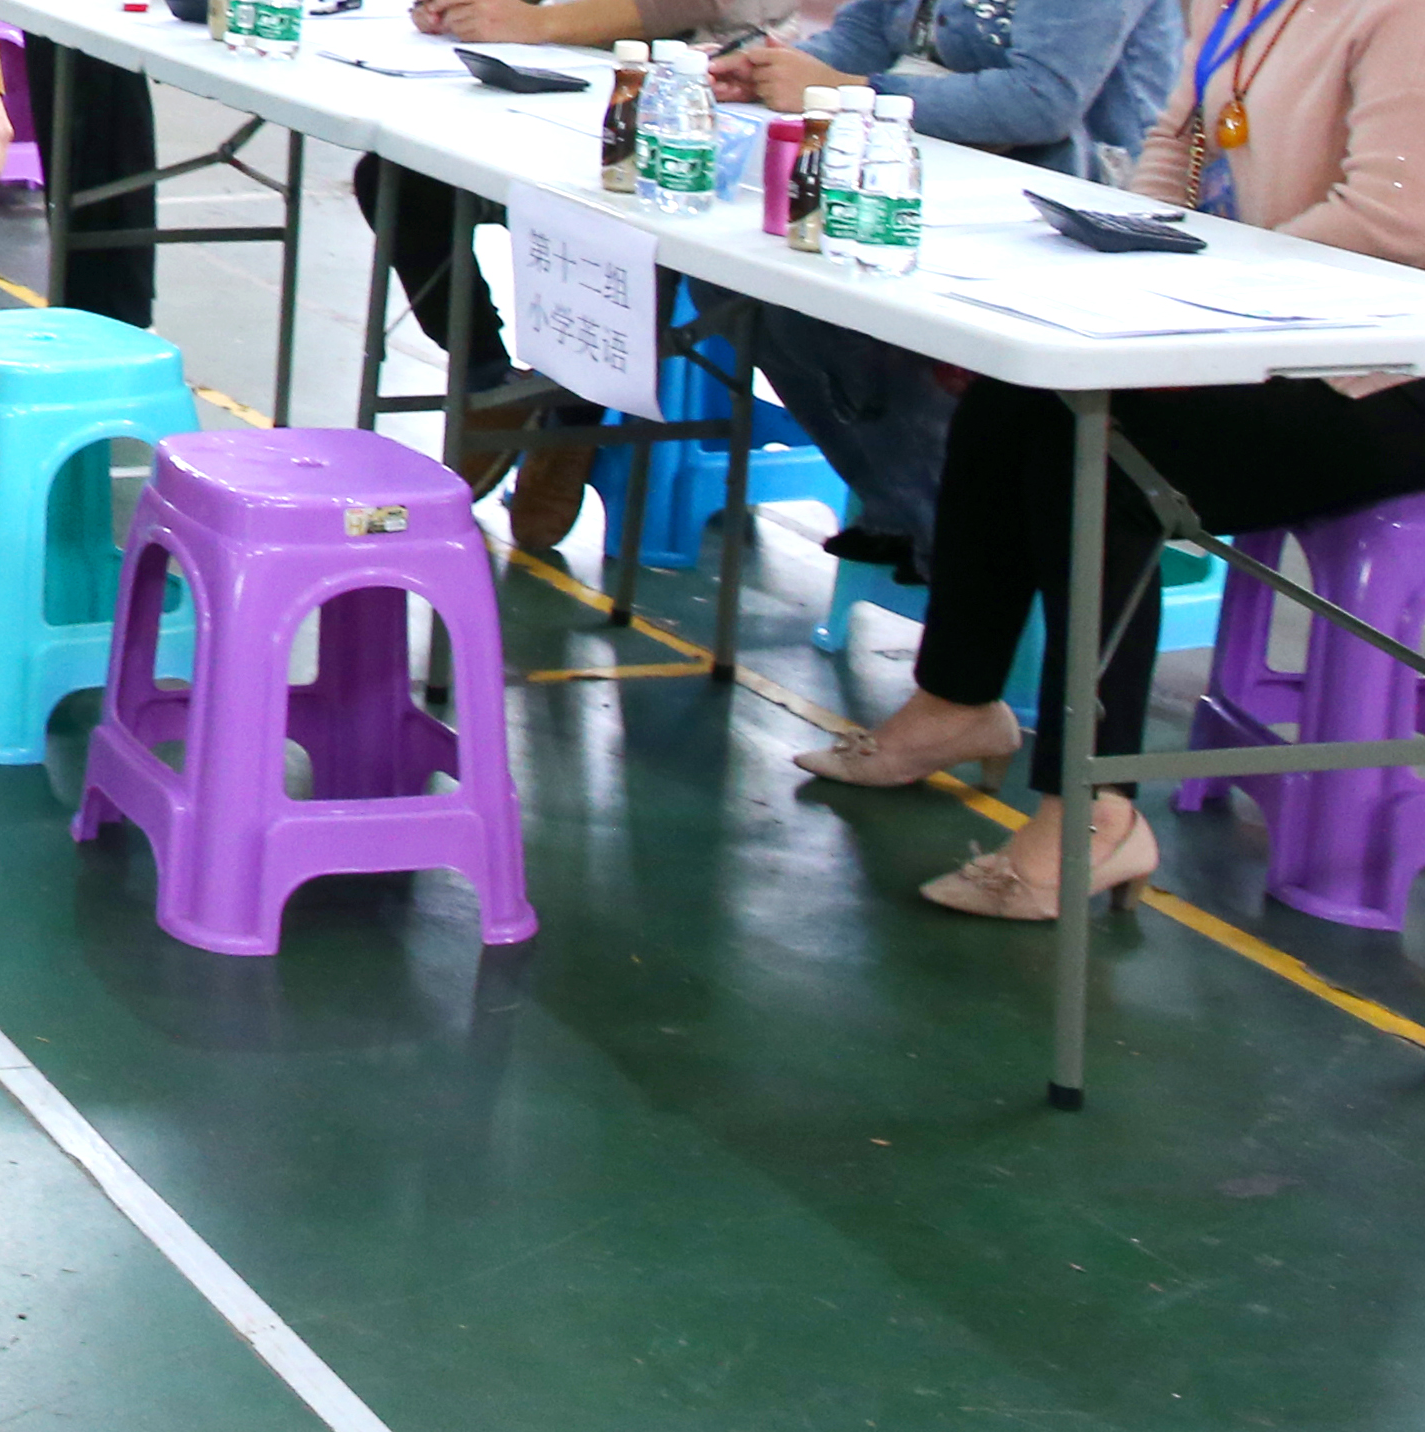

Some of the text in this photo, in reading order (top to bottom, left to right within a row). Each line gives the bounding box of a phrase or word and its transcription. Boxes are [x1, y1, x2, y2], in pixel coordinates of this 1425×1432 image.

[527, 228, 631, 309] 第十二组
[529, 293, 629, 374] 小学英语
